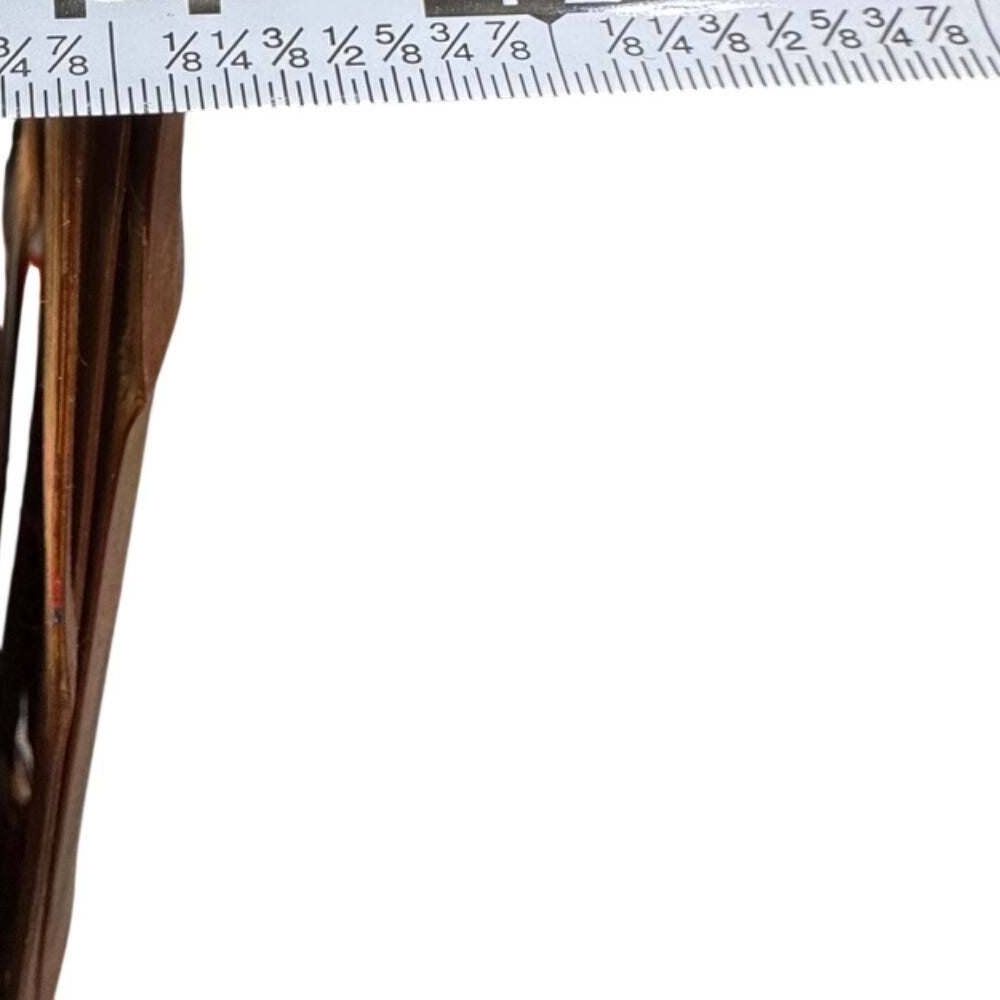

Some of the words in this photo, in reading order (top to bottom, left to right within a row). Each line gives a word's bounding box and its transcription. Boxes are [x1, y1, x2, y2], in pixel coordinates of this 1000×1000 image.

[46, 34, 89, 76] 7/8
[162, 31, 203, 72] 1/8
[210, 28, 253, 70] 1/4
[262, 26, 310, 68] 3/8
[322, 25, 367, 67] 1/2
[374, 22, 422, 64] 5/8
[429, 21, 475, 62] 3/4
[484, 20, 531, 61] 7/8
[599, 16, 644, 57] 1/8
[647, 15, 693, 54] 1/4
[700, 12, 751, 54] 3/8
[757, 11, 806, 51] 1/2
[809, 8, 862, 50] 5/8
[862, 6, 913, 47] 3/4
[914, 5, 970, 46] 7/8
